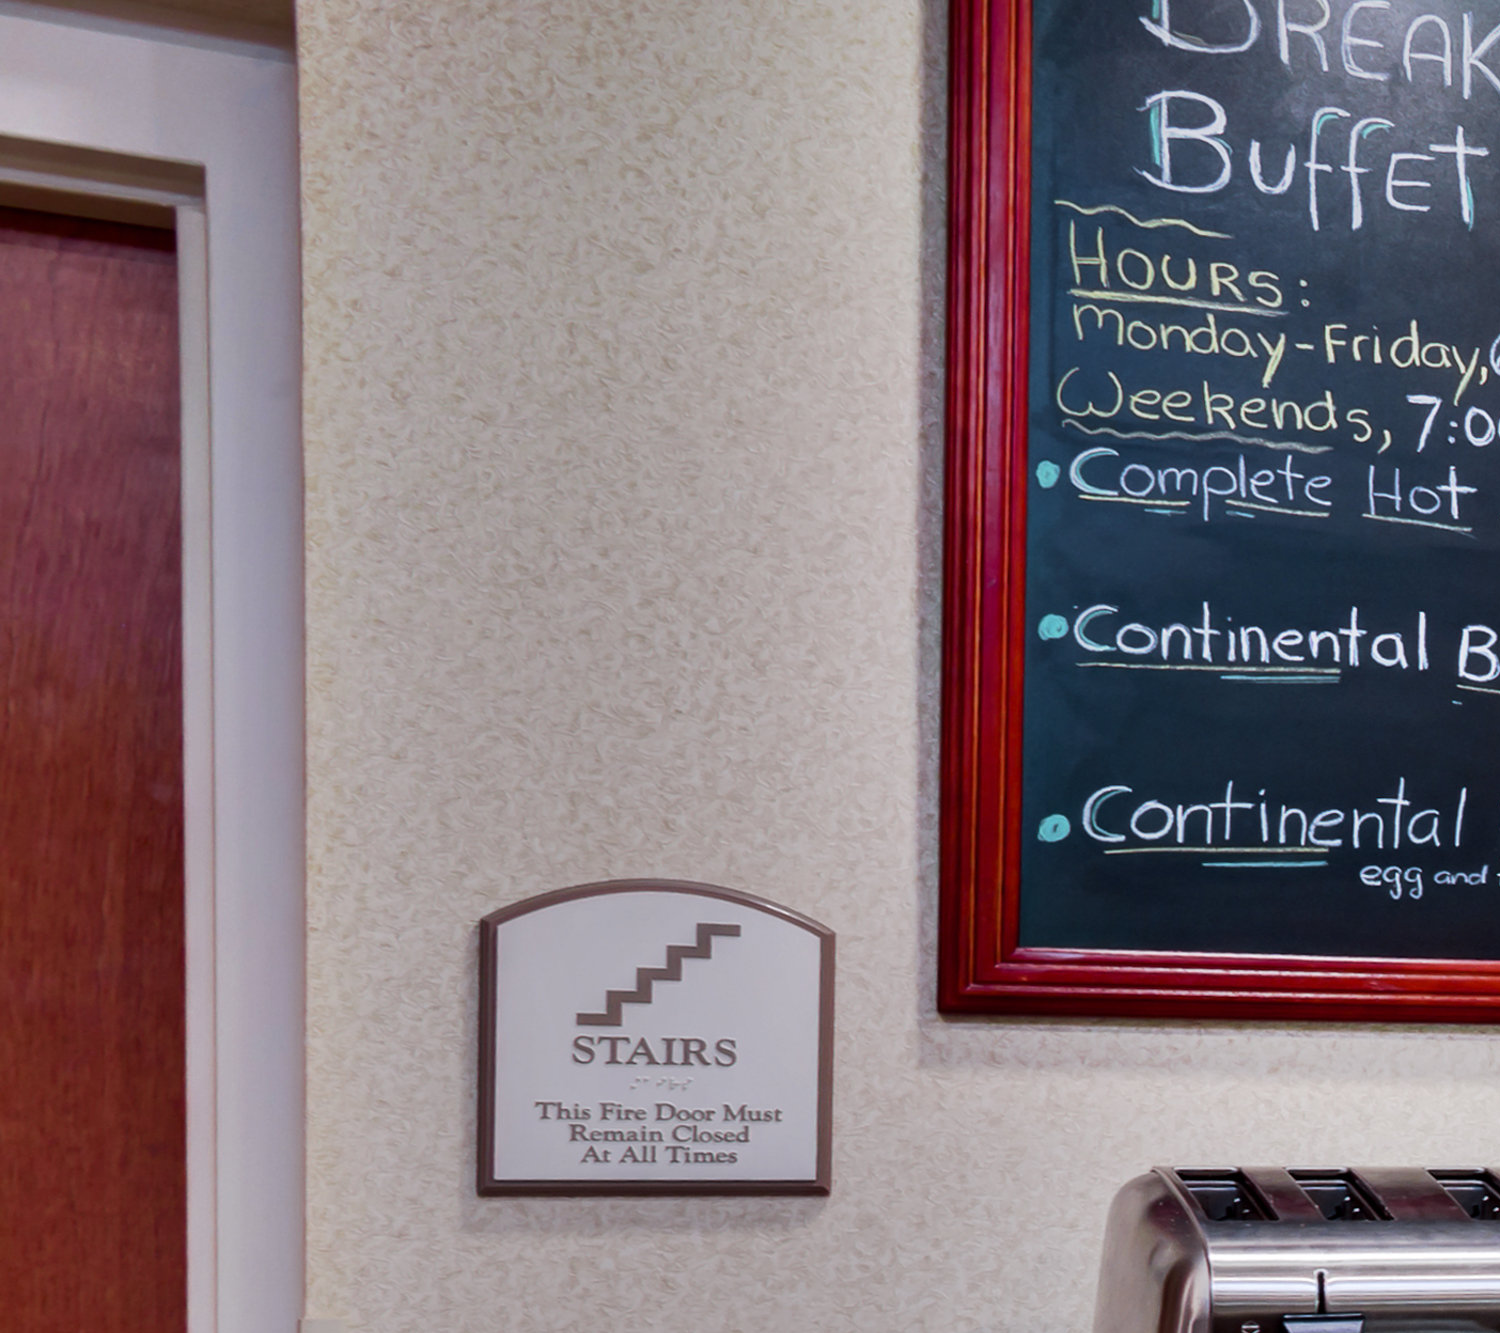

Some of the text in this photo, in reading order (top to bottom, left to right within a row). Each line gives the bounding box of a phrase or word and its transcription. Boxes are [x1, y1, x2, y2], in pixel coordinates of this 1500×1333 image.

[1056, 367, 1391, 454] Weekends,
[1069, 447, 1332, 521] Complete
[1368, 465, 1478, 519] Hot
[1073, 601, 1430, 671] Continental
[1082, 776, 1467, 850] Continental
[1359, 864, 1423, 899] egg
[1434, 865, 1488, 886] and
[571, 1035, 738, 1067] STAIRS
[534, 1101, 783, 1123] This Fire Door Must
[568, 1124, 750, 1144] Remain Closed
[580, 1145, 738, 1164] At All Times
